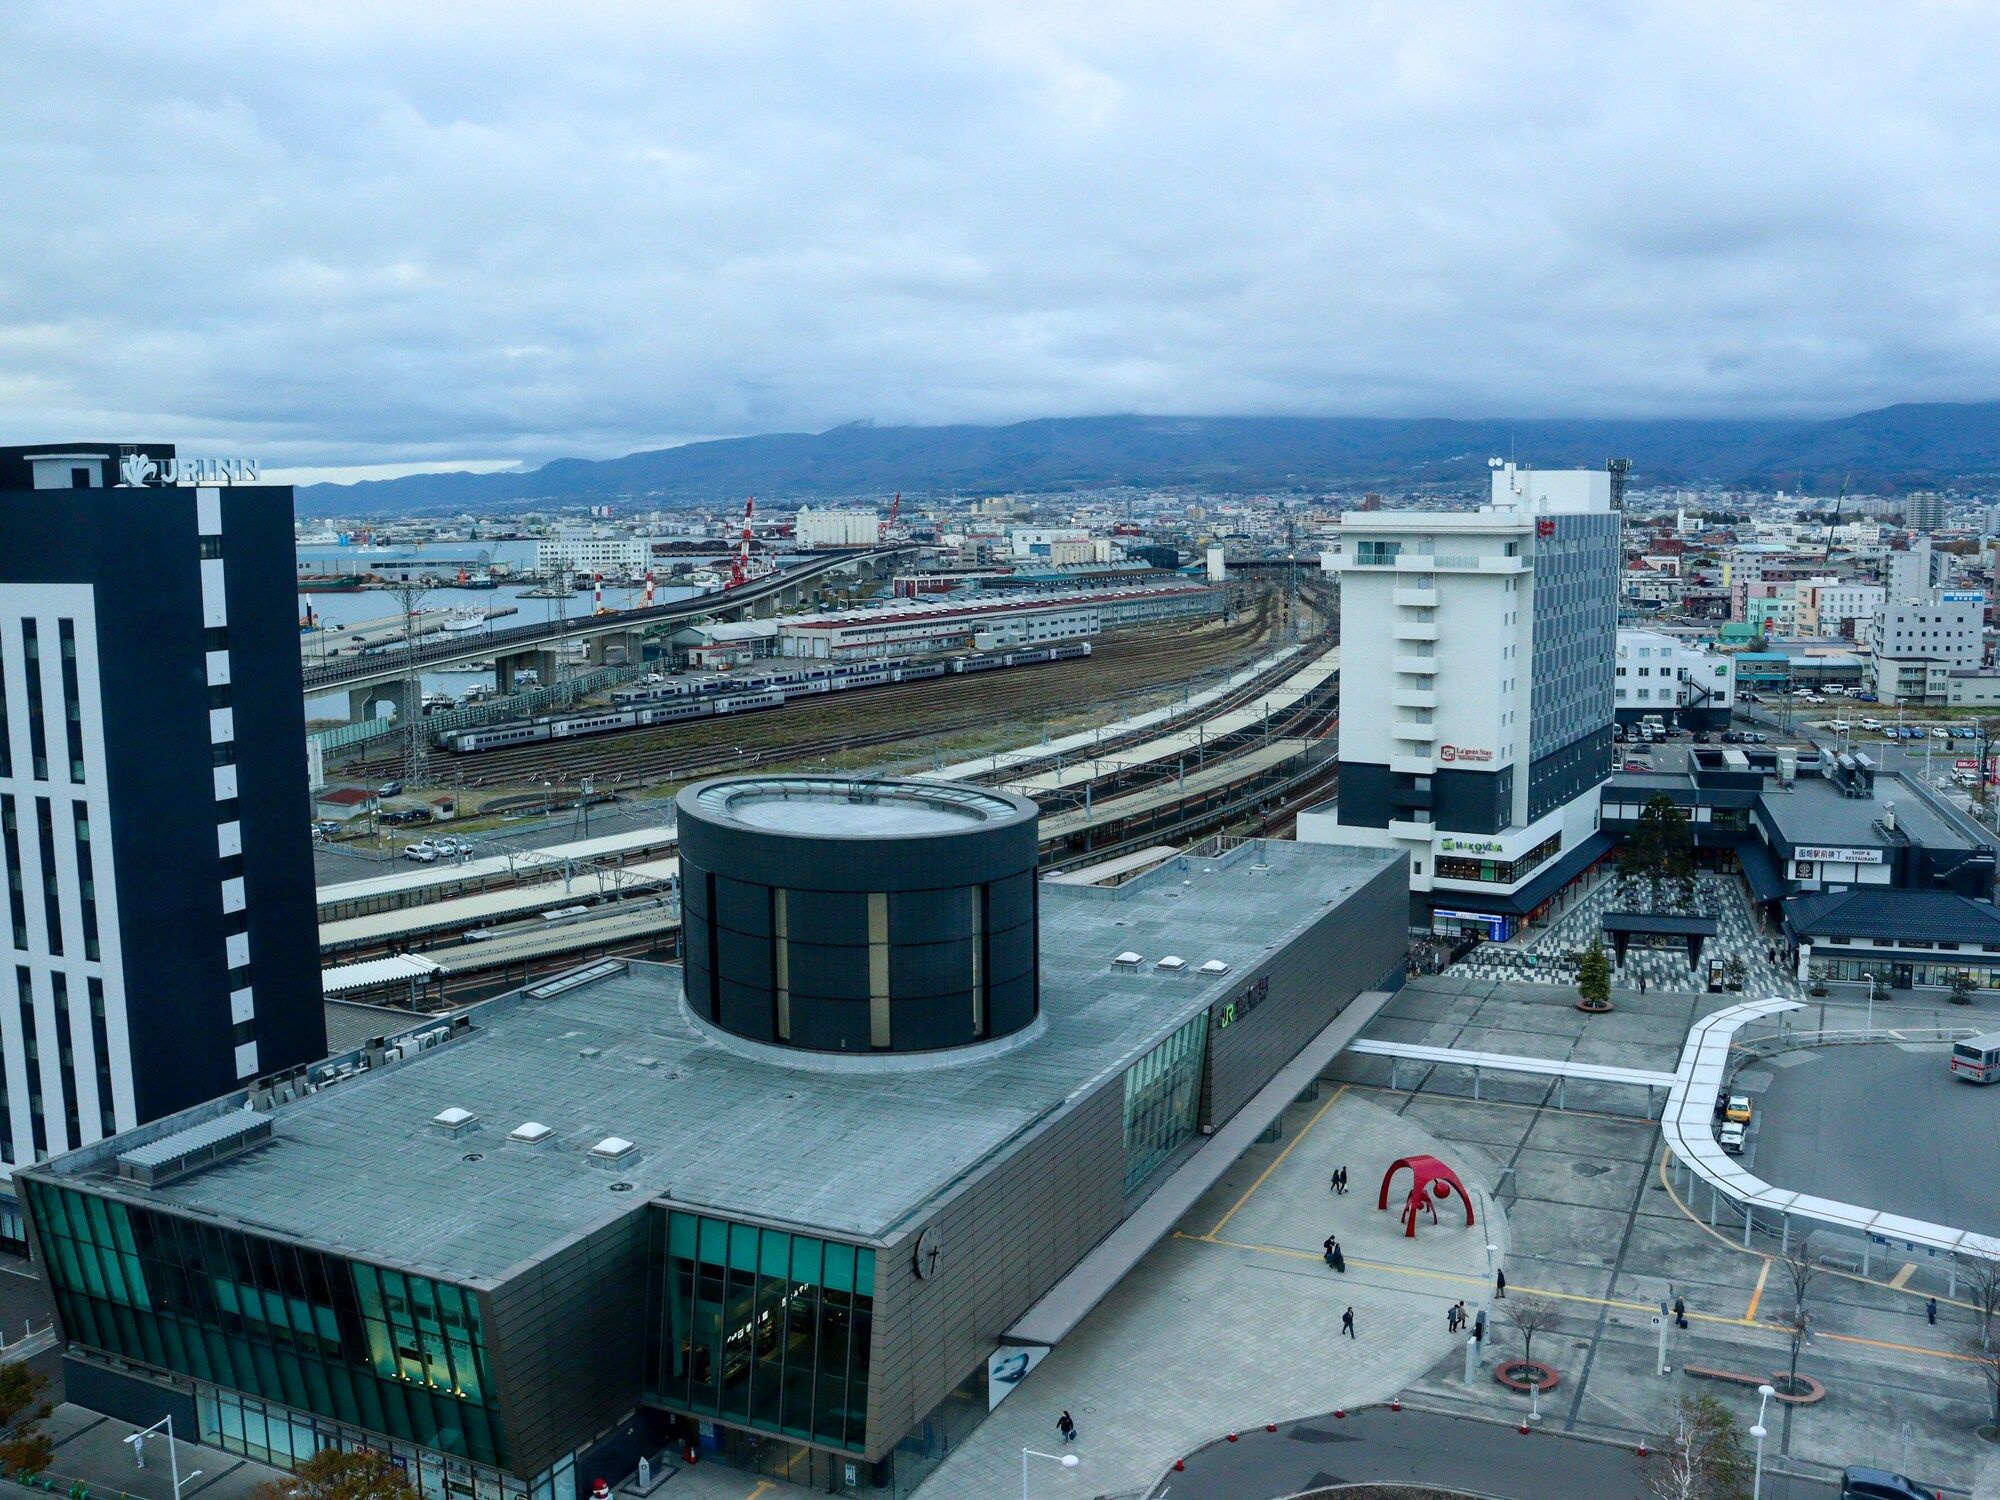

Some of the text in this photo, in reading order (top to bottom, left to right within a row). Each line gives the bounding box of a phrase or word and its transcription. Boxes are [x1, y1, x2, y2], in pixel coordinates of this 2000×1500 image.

[1479, 748, 1493, 757] Stay
[1456, 840, 1504, 853] HAKOVIVA
[1220, 1003, 1234, 1028] JR
